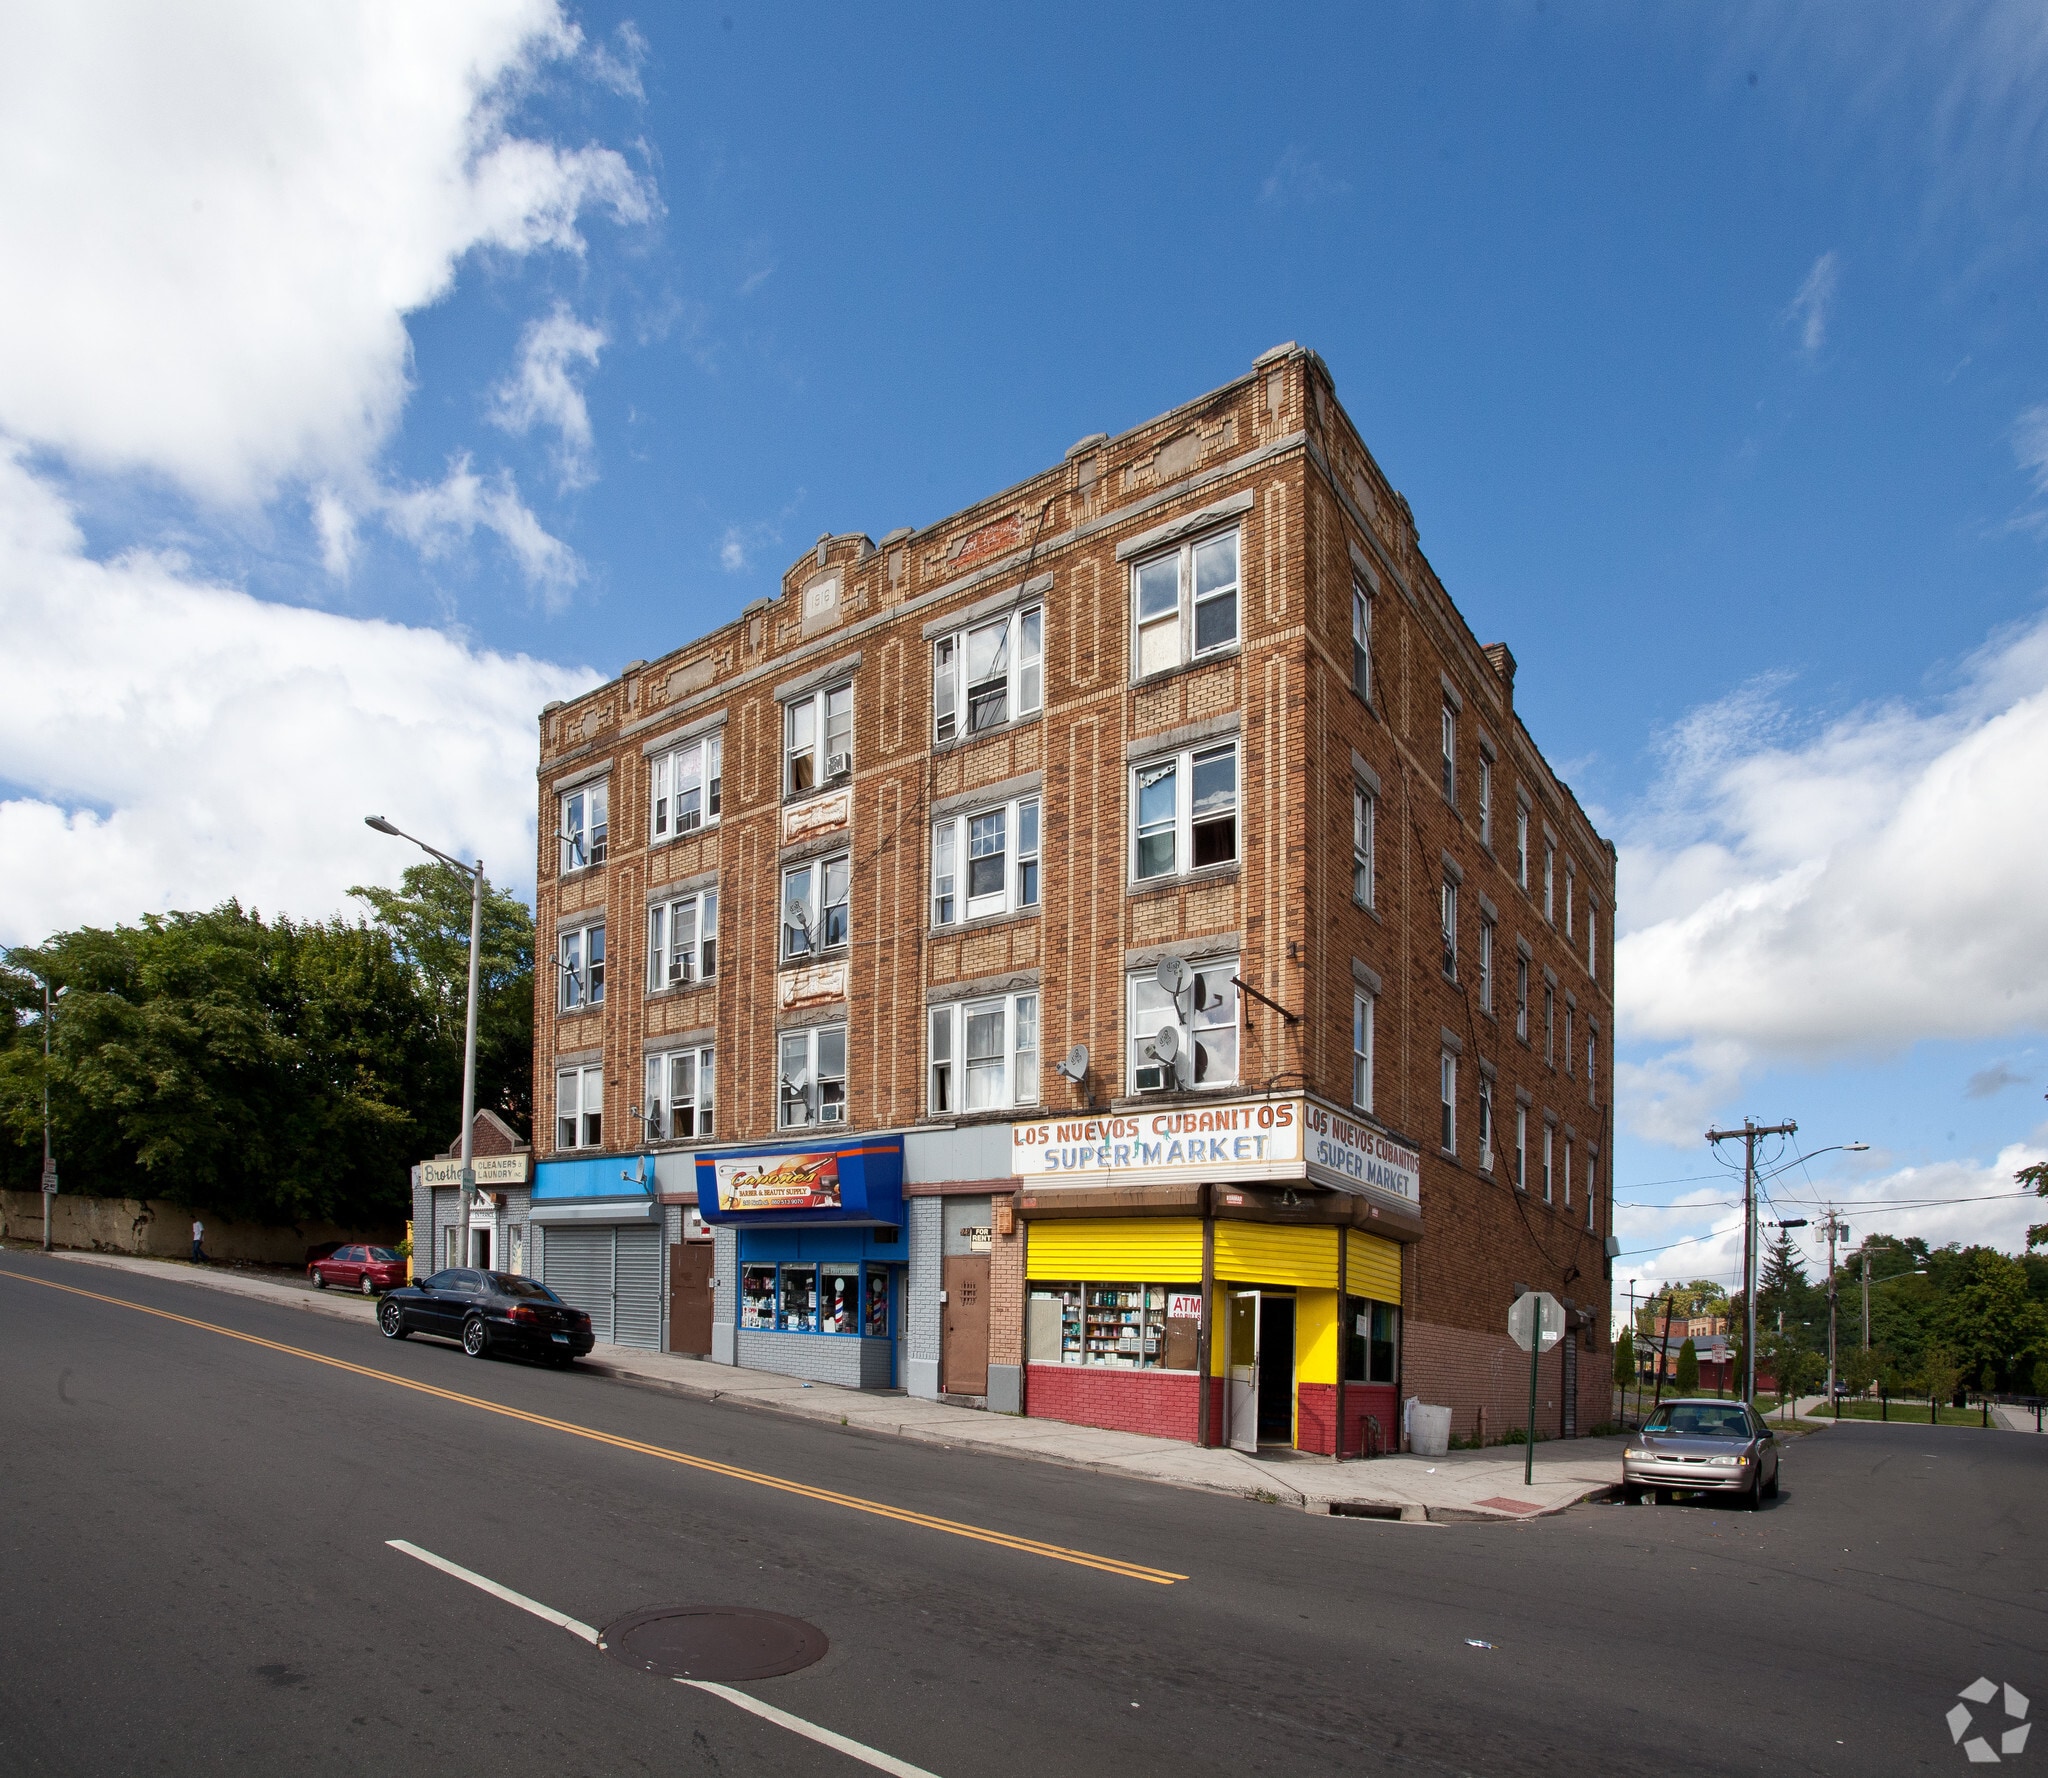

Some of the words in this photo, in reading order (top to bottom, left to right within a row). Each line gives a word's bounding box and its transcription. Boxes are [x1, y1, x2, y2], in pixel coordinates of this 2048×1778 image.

[811, 589, 830, 609] 1916
[1014, 1125, 1049, 1146] LOS
[1057, 1118, 1140, 1143] NUEVOS
[1152, 1103, 1294, 1135] CUBANITOS
[1306, 1105, 1328, 1135] LOS
[1332, 1117, 1374, 1155] NUEVOS
[1375, 1138, 1420, 1175] CUBANITOS
[1044, 1144, 1131, 1171] SUPER
[1142, 1135, 1268, 1165] MARKET
[424, 1164, 464, 1182] Brothe
[478, 1160, 517, 1169] CLEANERS
[478, 1170, 512, 1179] LAUNDRY
[731, 1171, 817, 1188] Capones
[1318, 1140, 1363, 1179] SUPER
[1367, 1160, 1409, 1197] MARKET
[1173, 1297, 1201, 1313] ATM
